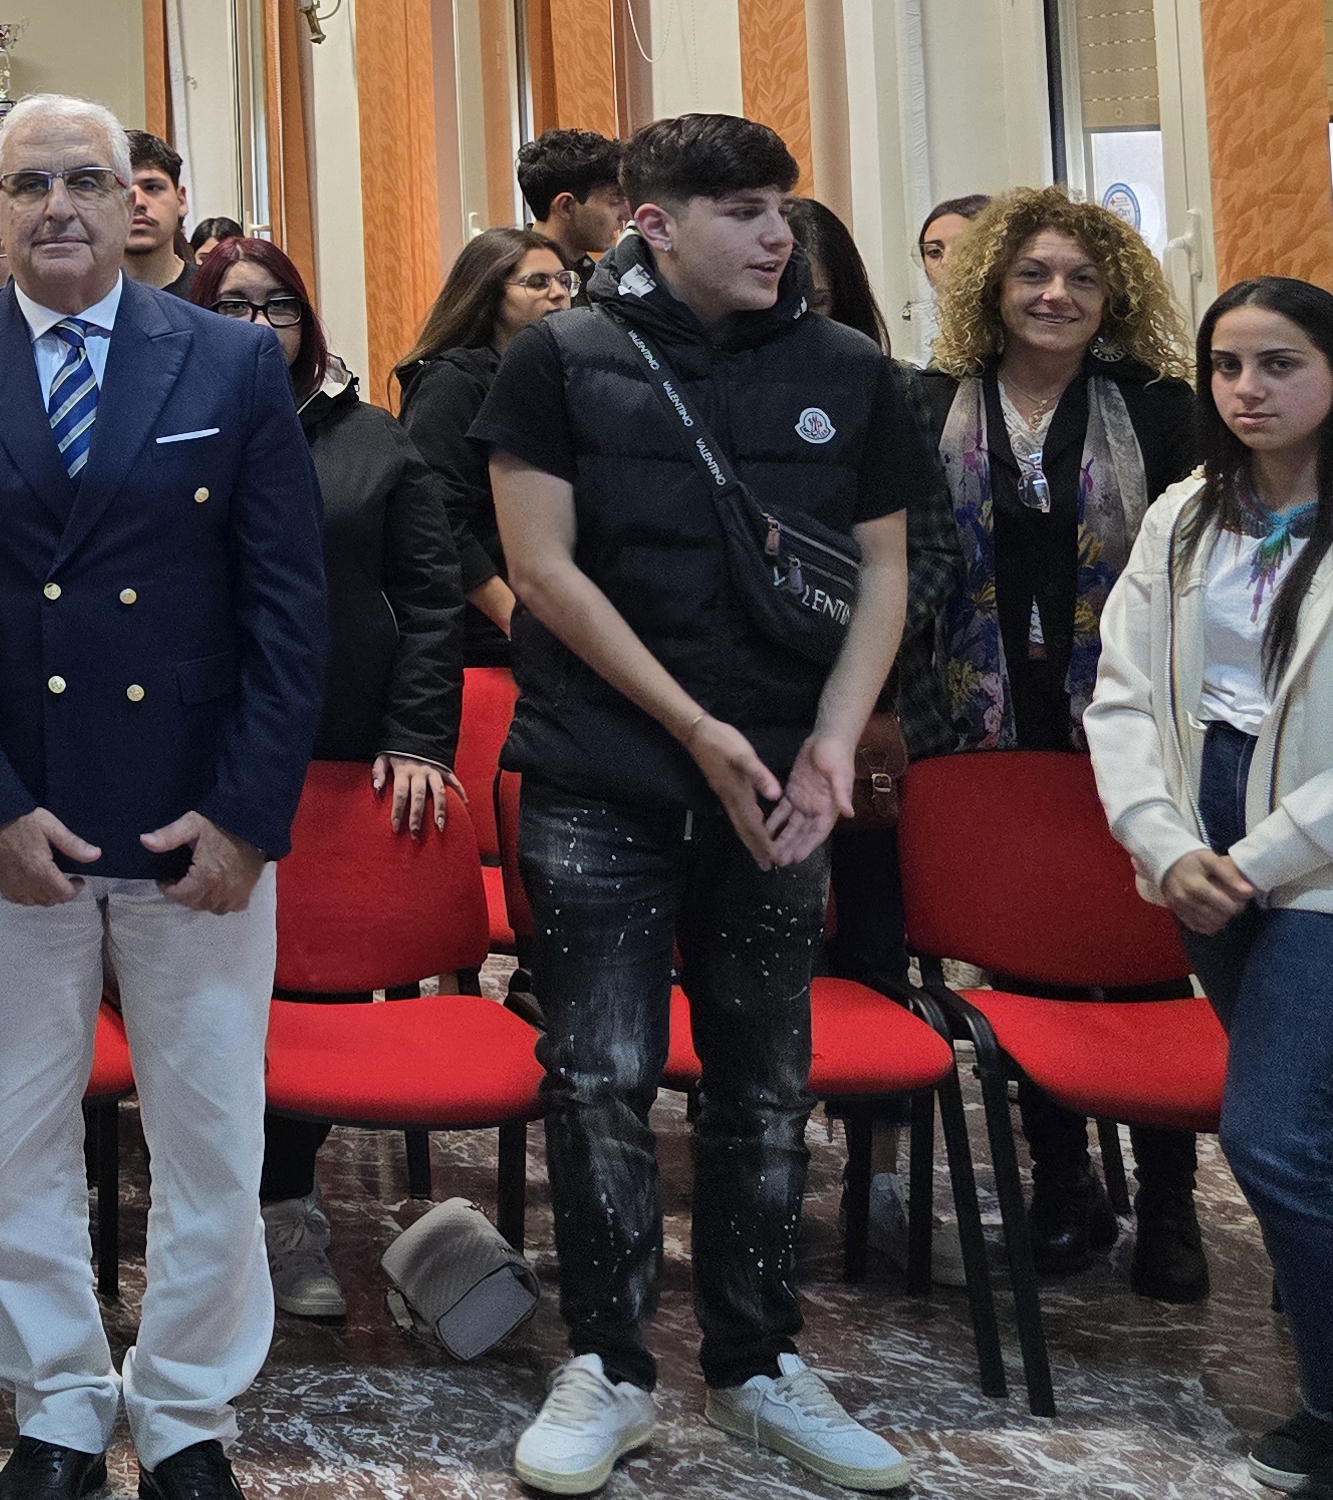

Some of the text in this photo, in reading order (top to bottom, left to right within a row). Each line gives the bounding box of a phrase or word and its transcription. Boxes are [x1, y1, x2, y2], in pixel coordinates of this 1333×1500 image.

[627, 329, 661, 371] VALENTINO
[662, 380, 694, 427] VALENTINO
[695, 437, 727, 486] VALENTINO
